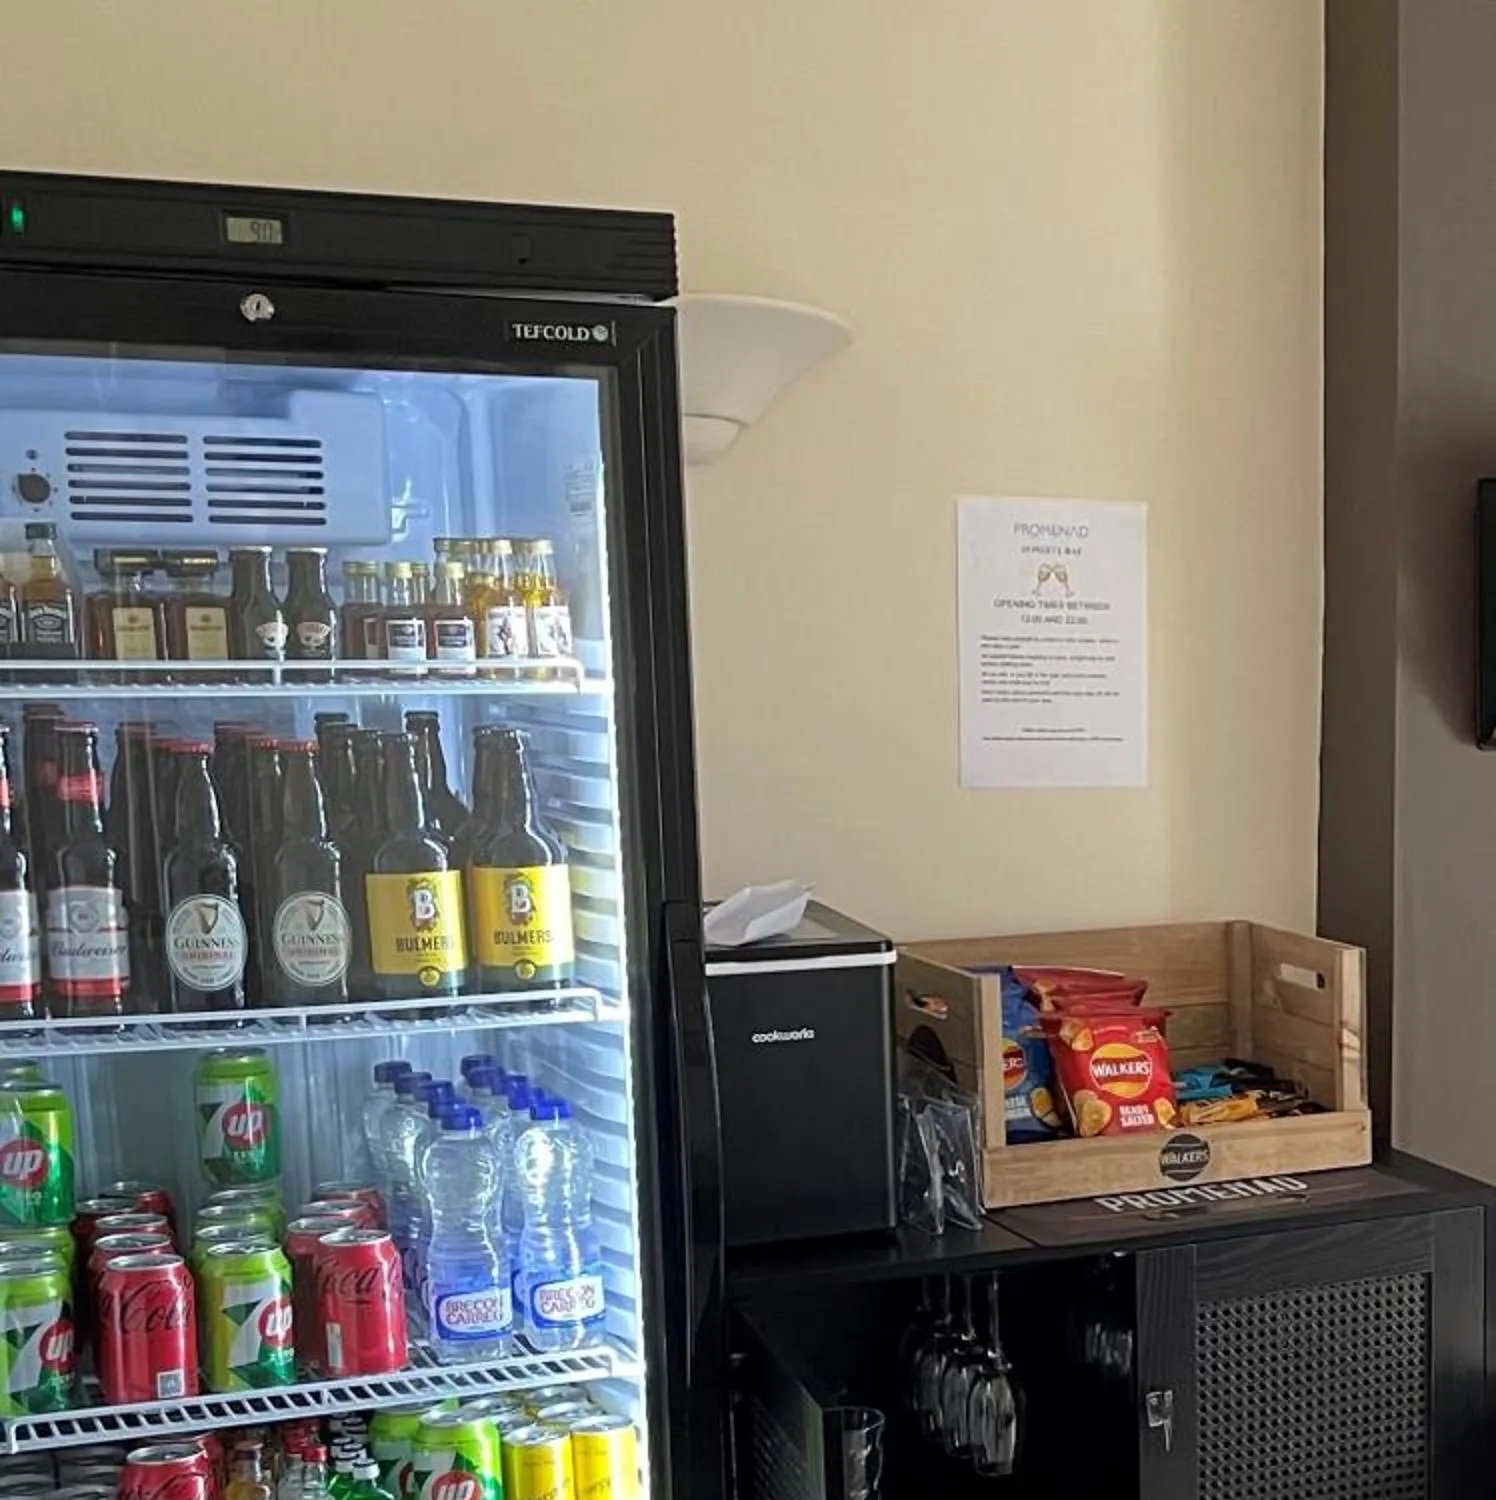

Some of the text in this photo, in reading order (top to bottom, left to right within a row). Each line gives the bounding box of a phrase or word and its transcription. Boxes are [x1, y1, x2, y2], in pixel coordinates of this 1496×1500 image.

[511, 323, 591, 341] TEFCOLD
[993, 598, 1036, 608] OPENING
[752, 1027, 815, 1043] cookworks
[1092, 1061, 1151, 1078] WALKERS
[1160, 1149, 1210, 1166] WALKERS
[1094, 1175, 1310, 1213] PROMENAD
